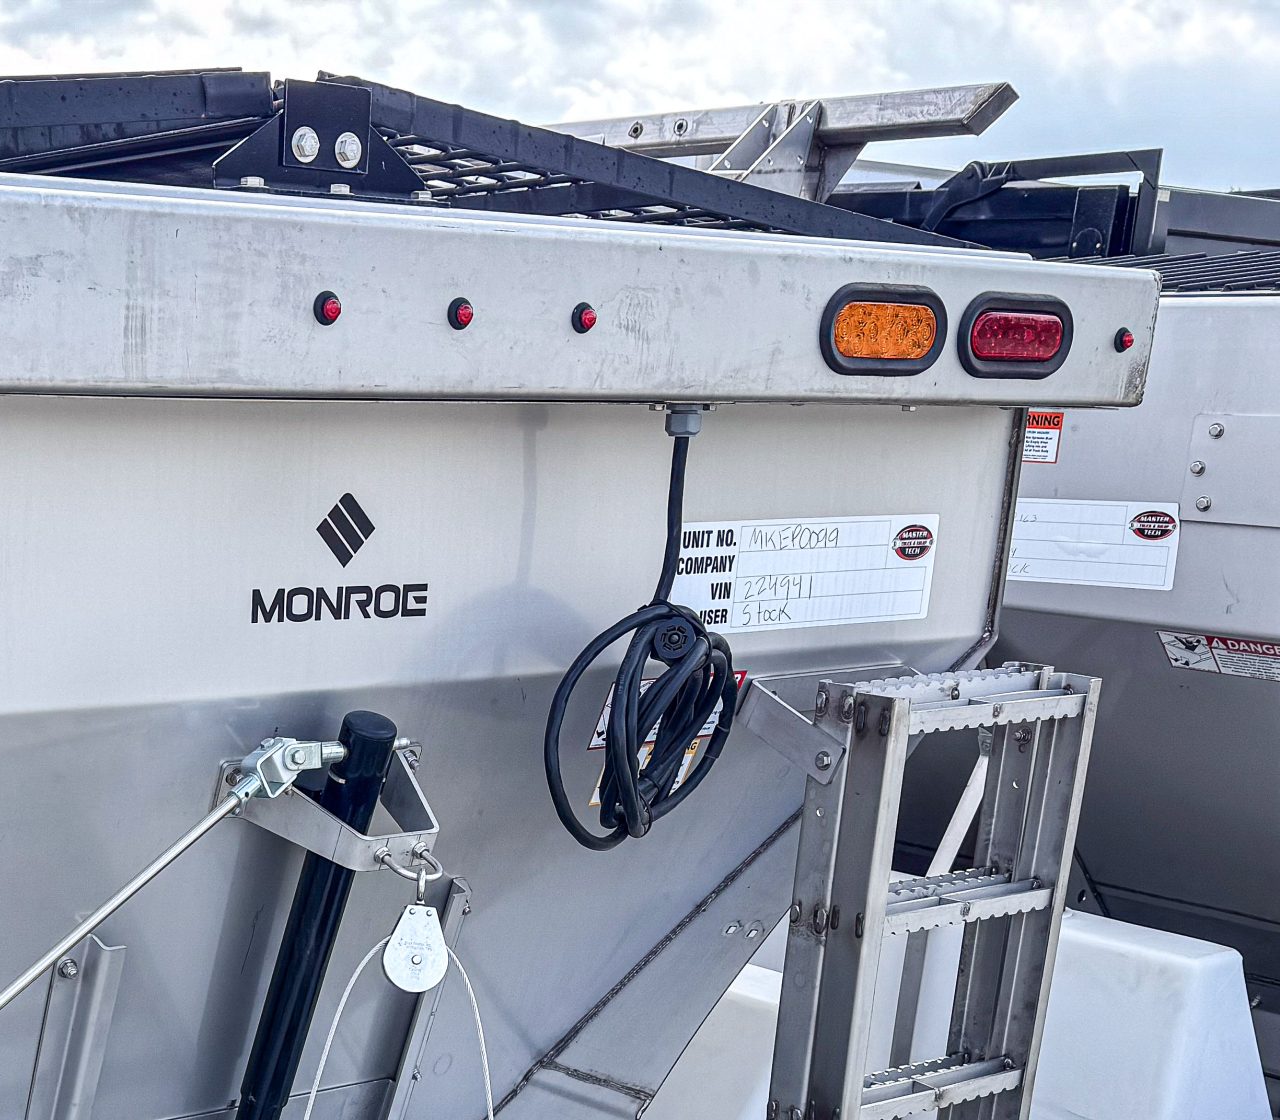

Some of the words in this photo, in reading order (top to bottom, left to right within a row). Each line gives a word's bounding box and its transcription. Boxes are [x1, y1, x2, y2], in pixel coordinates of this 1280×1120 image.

[682, 530, 713, 549] UNIT
[716, 529, 737, 547] NO.
[901, 530, 928, 539] MASTER
[906, 547, 921, 555] TECH
[676, 555, 736, 575] COMPANY
[710, 582, 732, 600] VIN
[250, 583, 429, 624] MONROE
